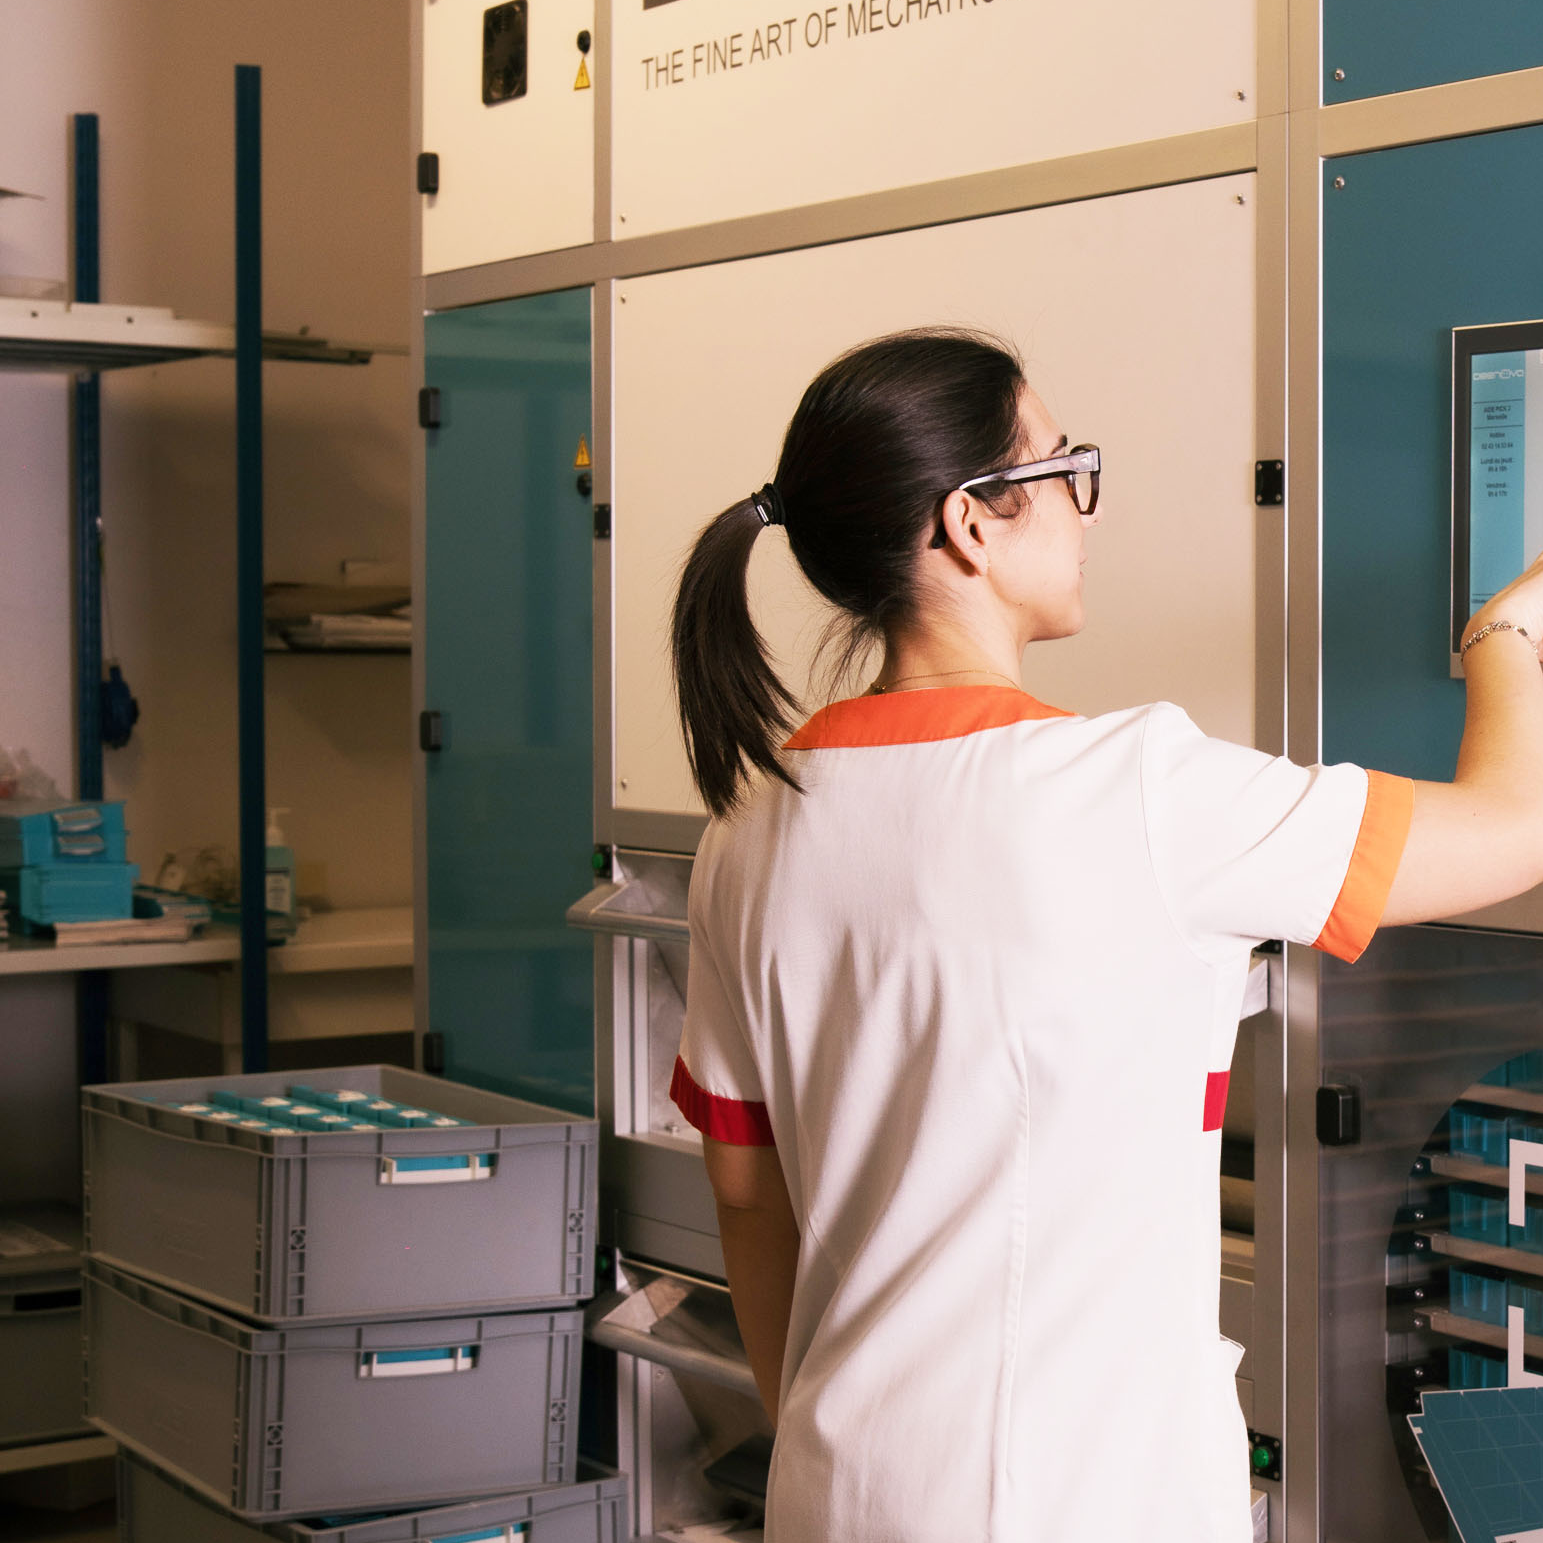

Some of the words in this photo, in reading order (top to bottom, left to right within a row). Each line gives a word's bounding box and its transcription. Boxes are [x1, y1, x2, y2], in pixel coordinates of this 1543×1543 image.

[641, 49, 684, 91] THE
[692, 32, 743, 79] FINE
[749, 18, 797, 65] ART
[804, 7, 839, 49] OF
